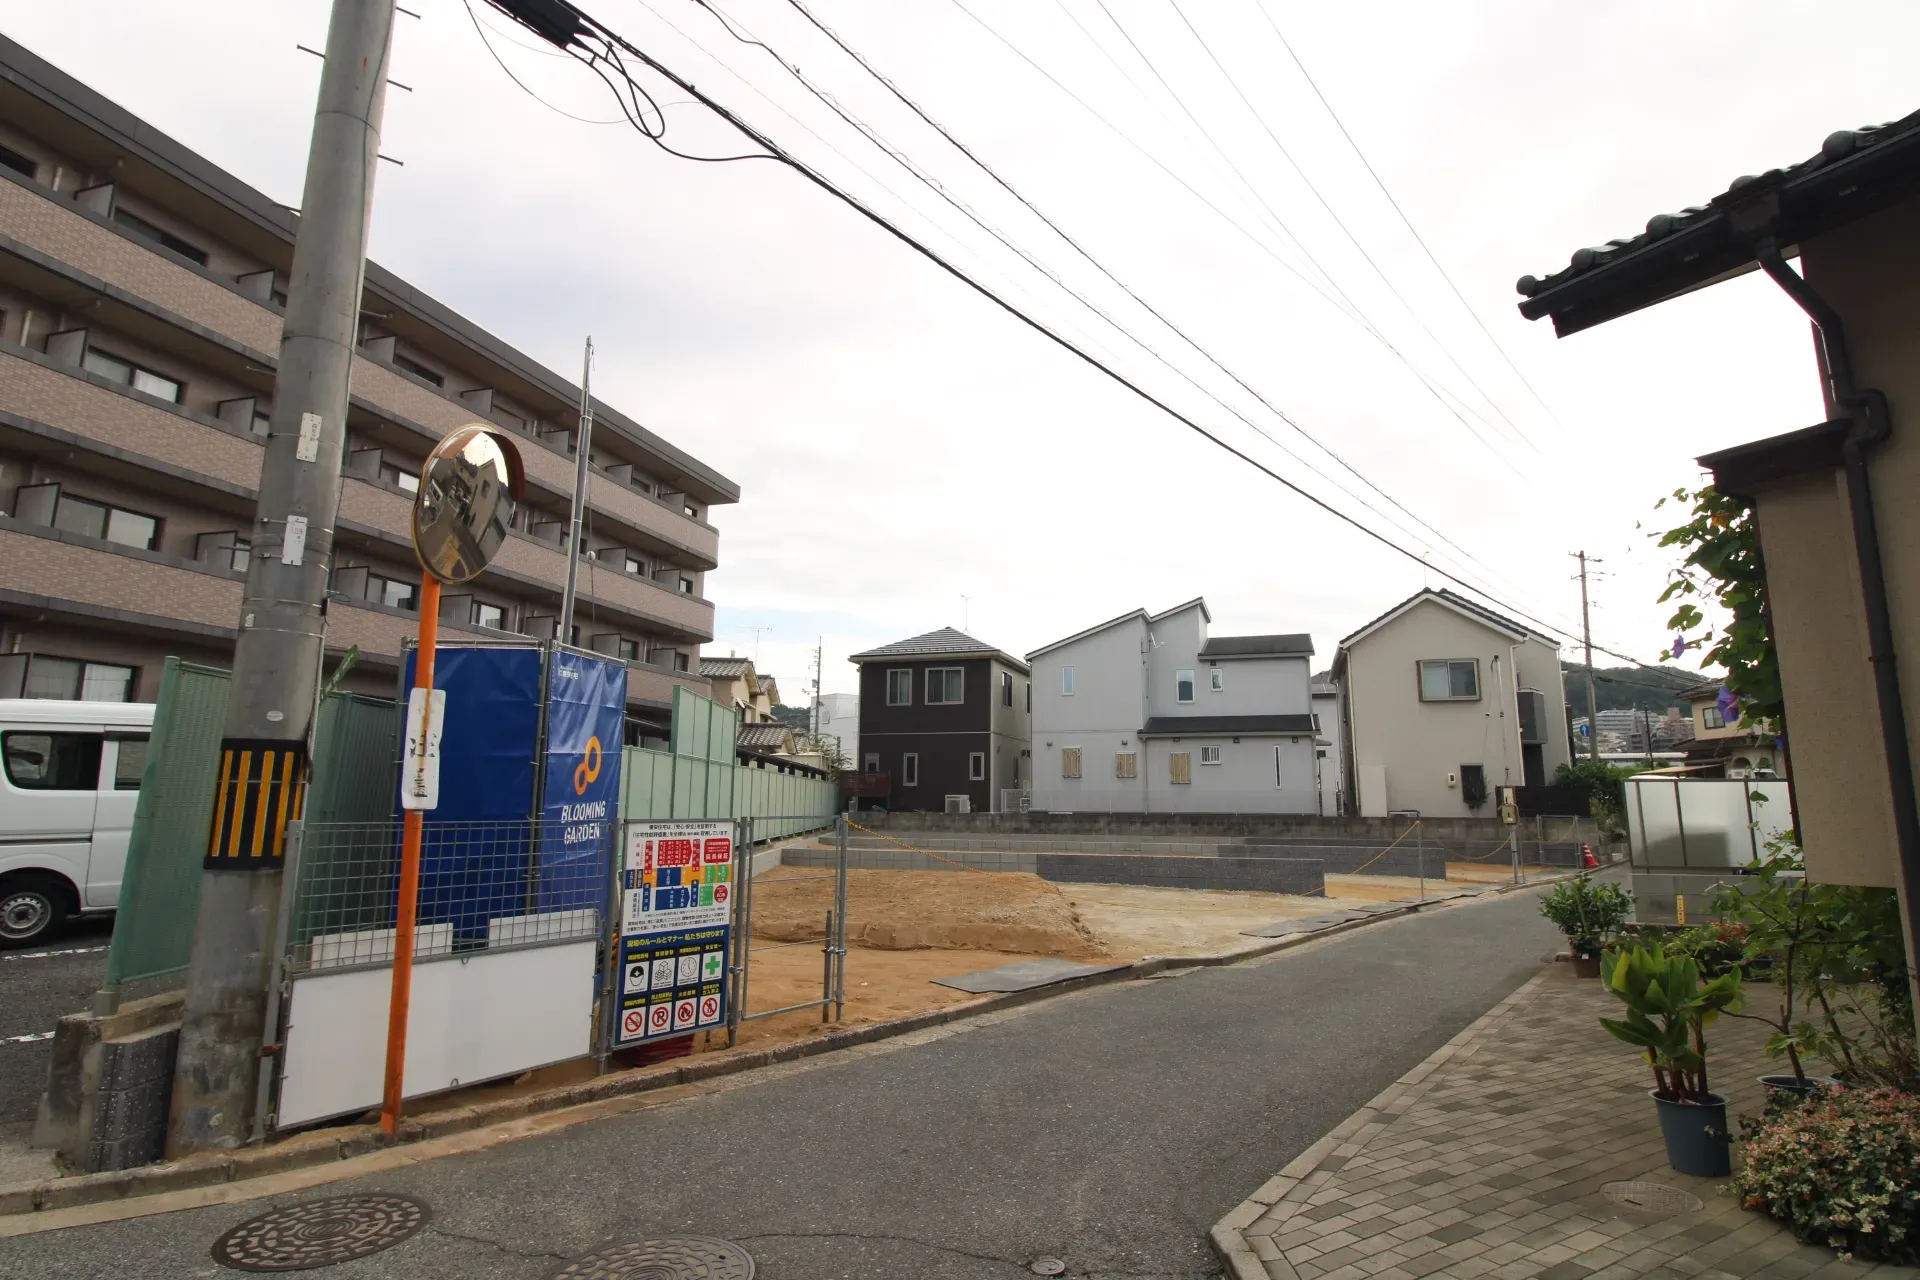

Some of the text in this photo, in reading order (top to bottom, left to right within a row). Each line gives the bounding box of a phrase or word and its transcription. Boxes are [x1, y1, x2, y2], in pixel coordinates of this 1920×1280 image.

[561, 800, 606, 824] BLOOMING
[564, 822, 600, 844] GARDEN
[627, 930, 724, 948] 現場のルールとマナー 私たちは守ります
